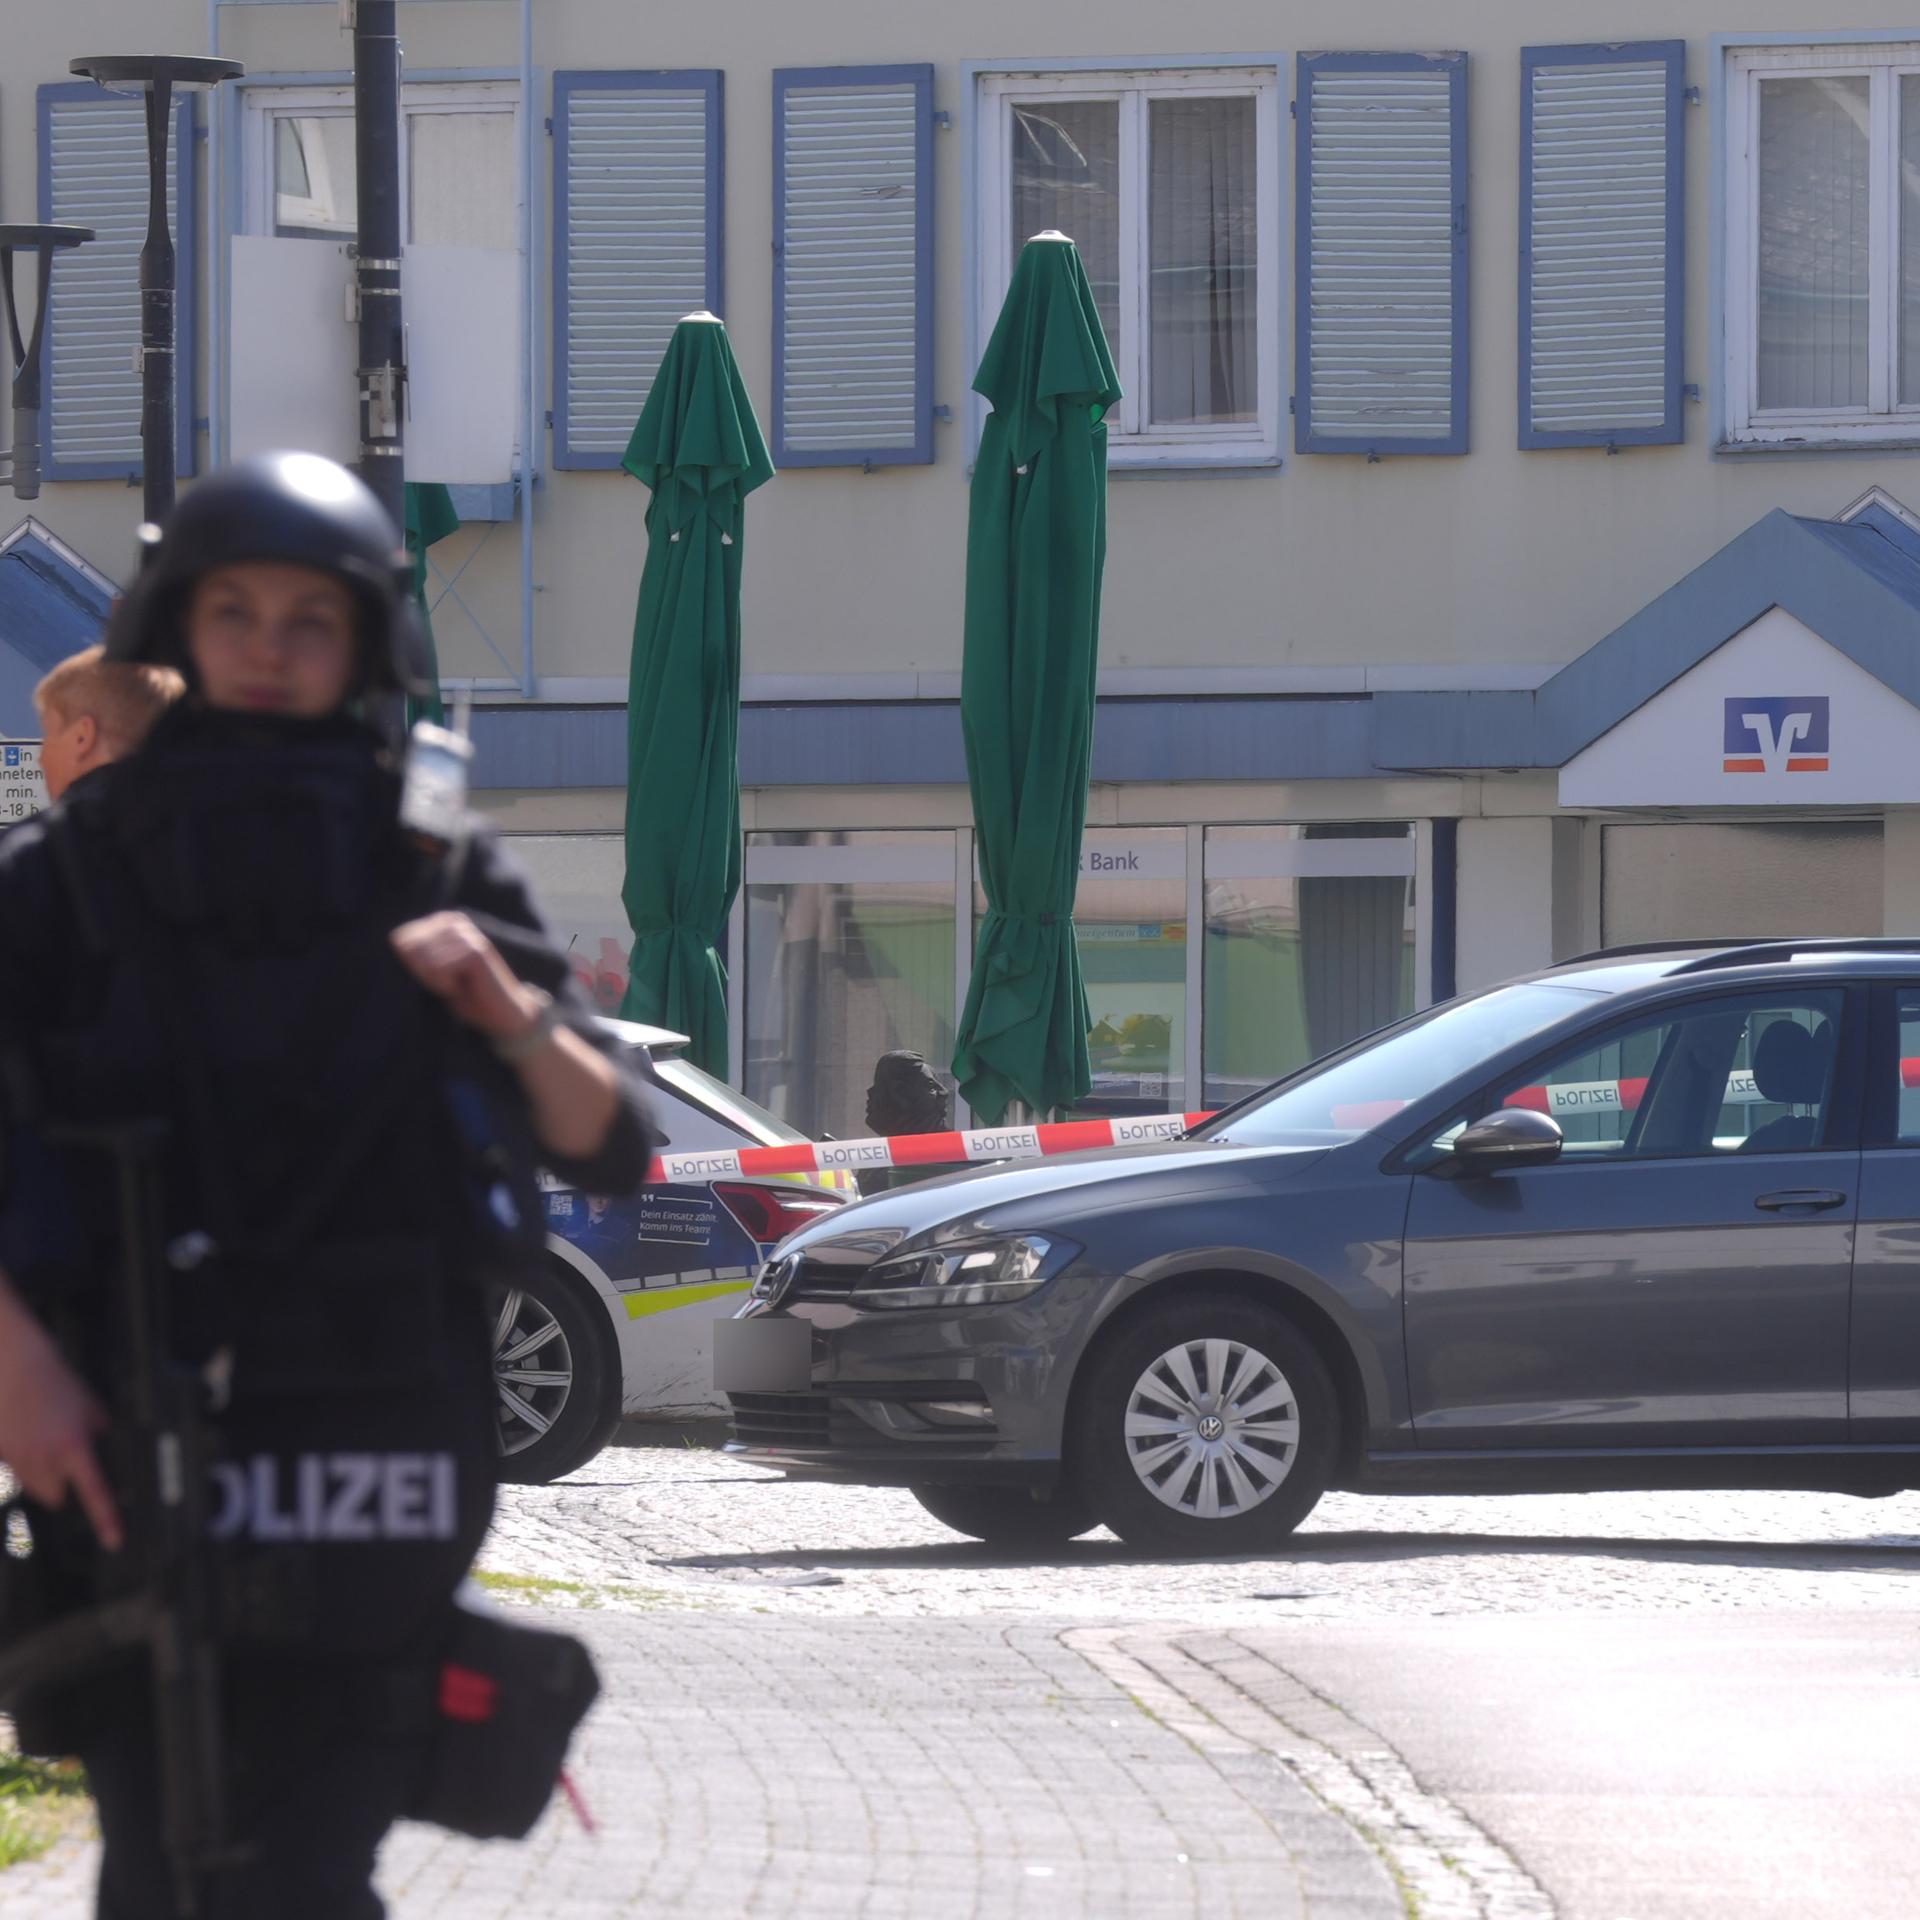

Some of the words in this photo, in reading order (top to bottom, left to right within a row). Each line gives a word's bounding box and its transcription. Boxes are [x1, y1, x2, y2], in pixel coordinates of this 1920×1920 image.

[20, 748, 33, 761] in
[6, 785, 38, 798] min.
[1091, 850, 1139, 870] Bank
[641, 1210, 661, 1220] Dein
[662, 1211, 694, 1221] Einsatz
[640, 1222, 668, 1232] Komm
[669, 1224, 683, 1233] ins
[209, 1453, 456, 1540] OLIZEI
